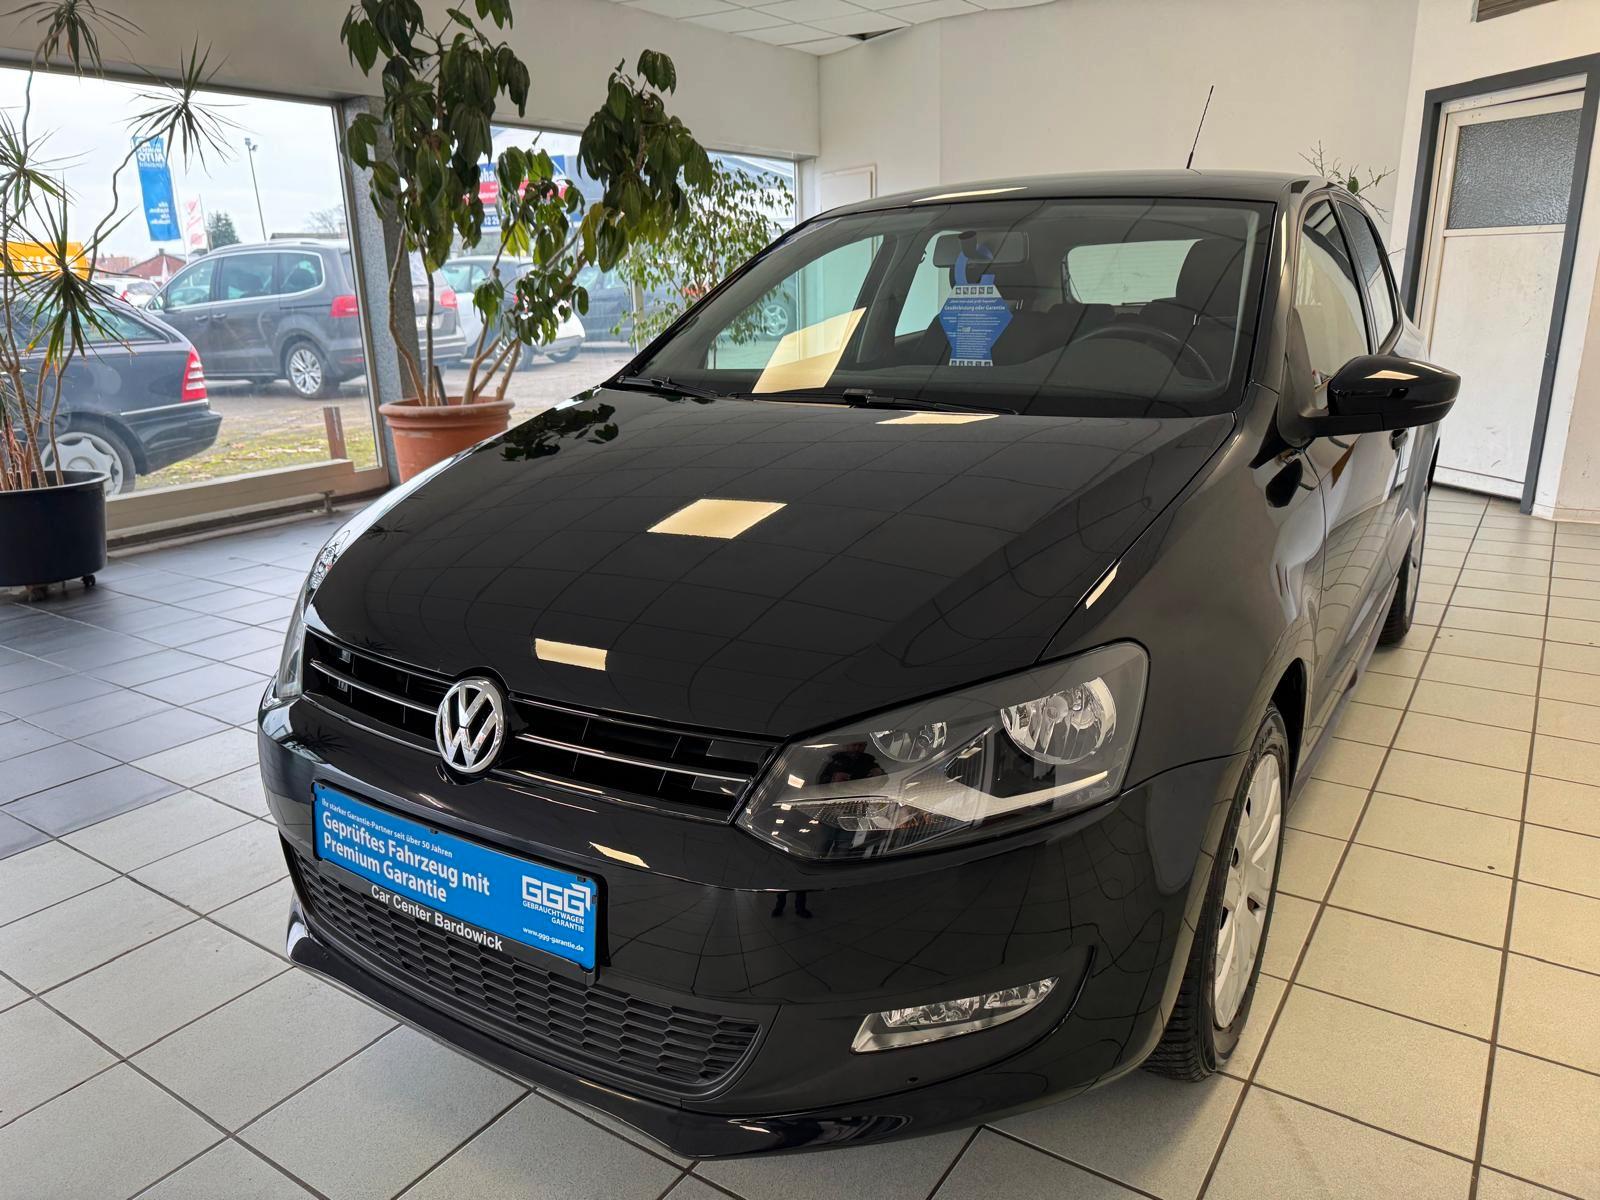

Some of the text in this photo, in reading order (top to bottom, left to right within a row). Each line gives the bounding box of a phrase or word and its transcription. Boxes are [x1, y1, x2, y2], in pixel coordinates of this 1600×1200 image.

[321, 798, 453, 858] Ihr starker Garantie-Partner seit über 50 Jahren
[322, 811, 490, 896] Geprüftes Fahrzeug mit
[323, 832, 447, 902] Premium Garantie
[371, 885, 503, 951] Car Center Bardowick
[521, 874, 590, 917] GGG
[522, 900, 585, 925] GEBRAUCHTWAGEN
[522, 926, 585, 952] www.ggg-garantie.de
[551, 916, 585, 933] GARANTIE
